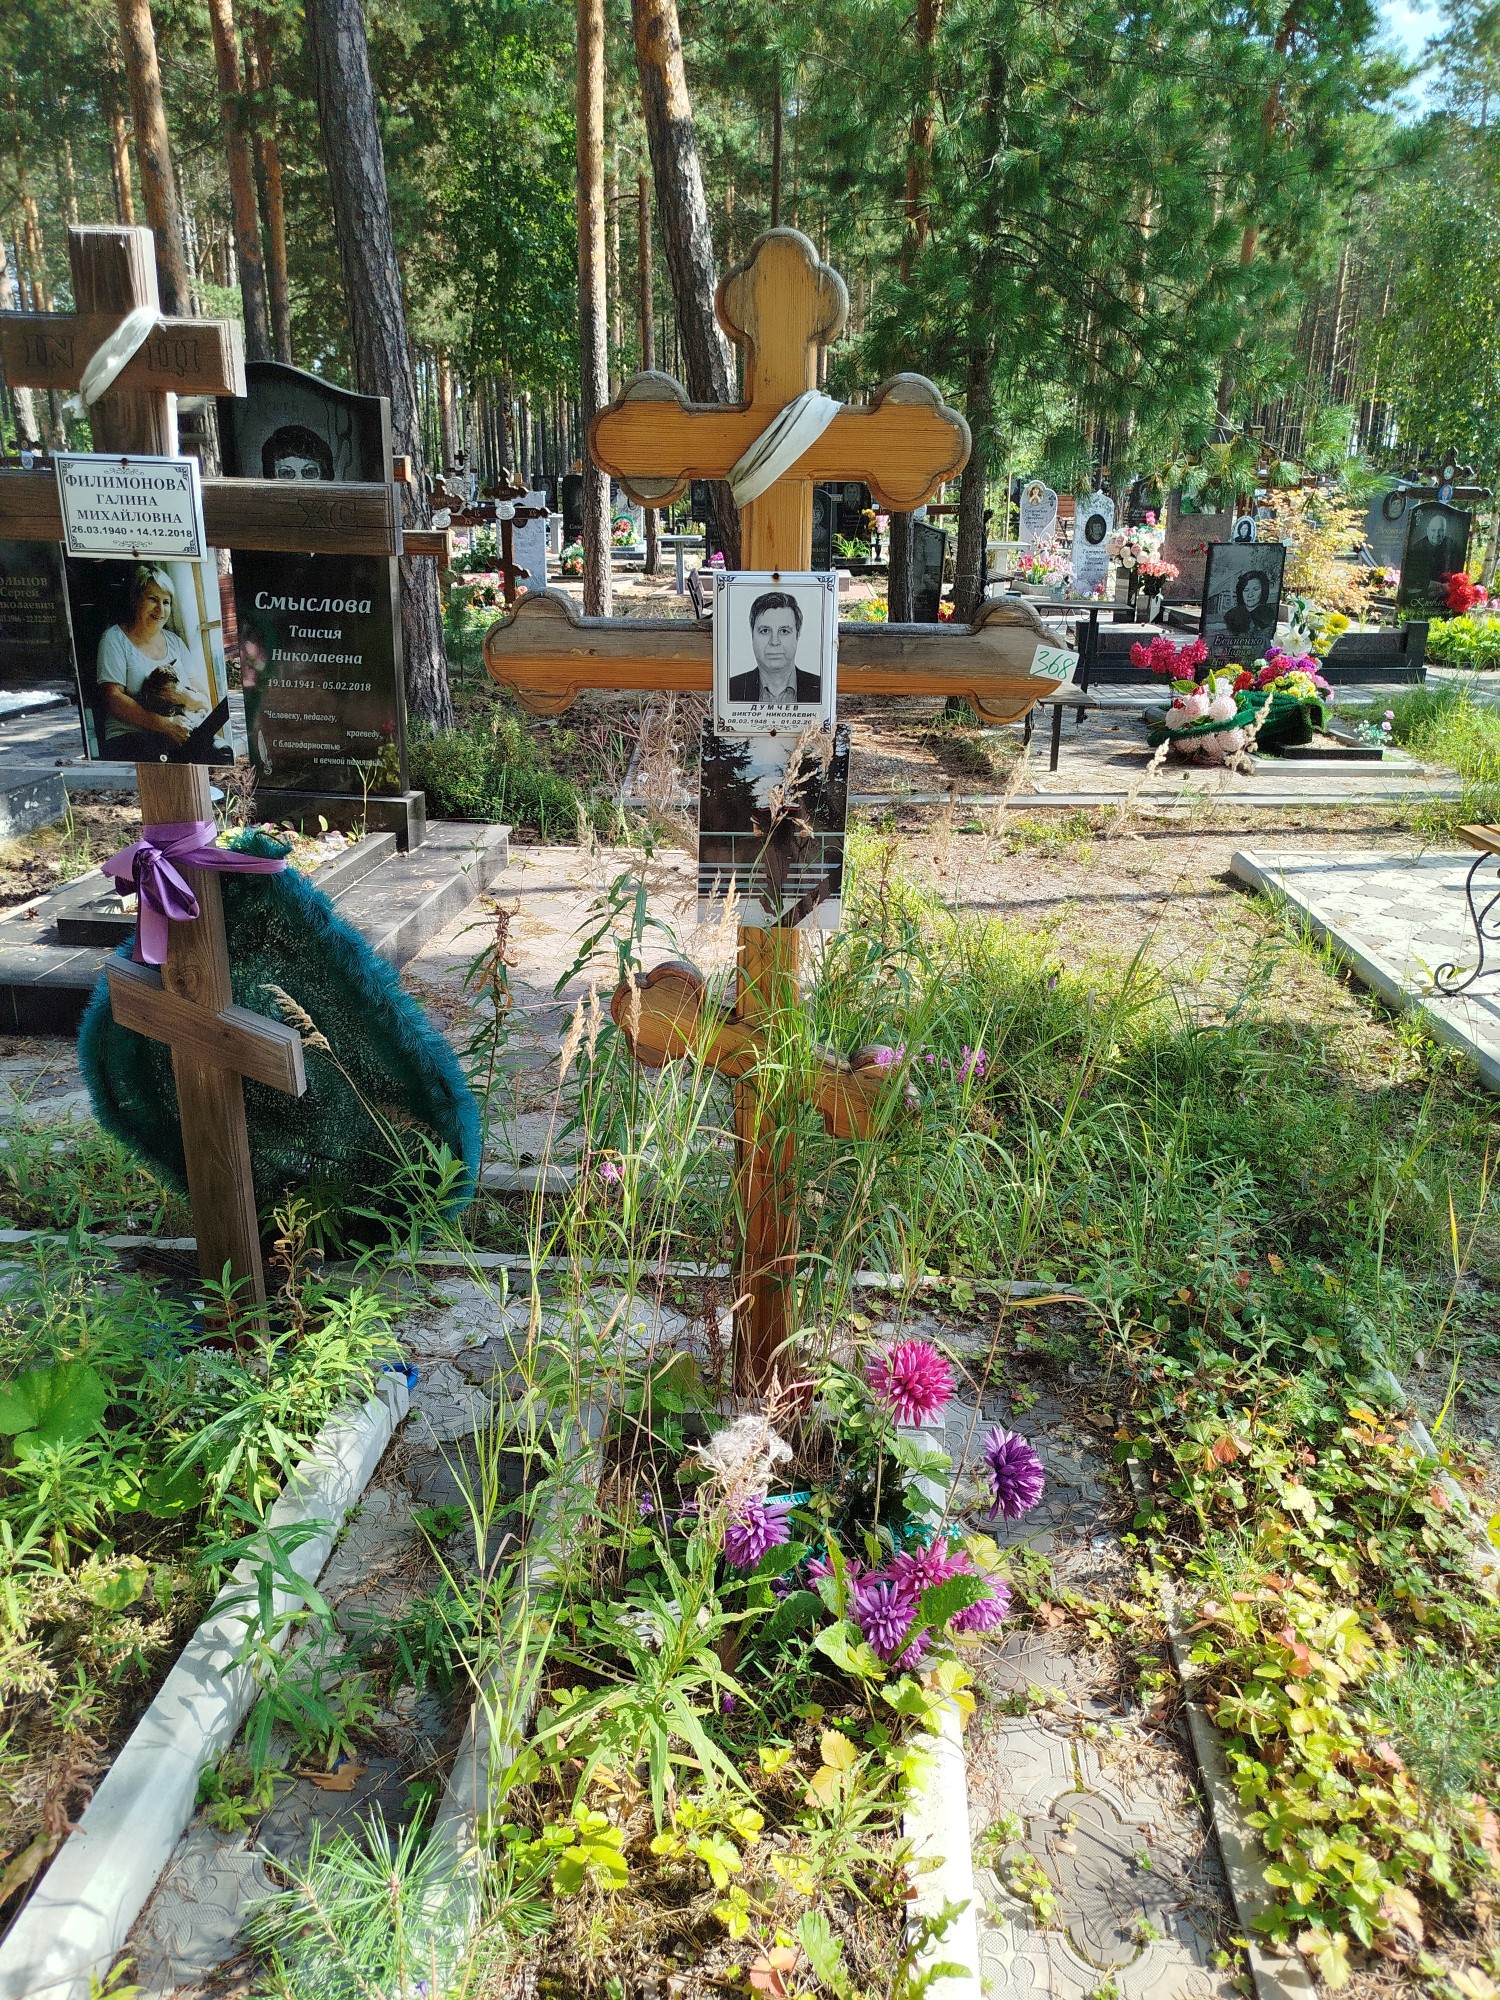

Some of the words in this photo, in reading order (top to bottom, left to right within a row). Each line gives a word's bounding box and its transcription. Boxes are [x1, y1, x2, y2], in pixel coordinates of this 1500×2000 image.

[65, 474, 188, 492] ФИЛИМОНОВА
[96, 493, 159, 507] ГАЛИНА
[77, 509, 183, 524] МИХАЙЛОВНА
[71, 525, 127, 535] 26.03.1940
[136, 528, 193, 538] 14.12.2018
[254, 591, 372, 614] Смыслова
[289, 624, 342, 640] Таисия
[271, 648, 363, 665] Николаевна
[1032, 650, 1076, 680] 368
[267, 678, 315, 689] 19.10.1941
[322, 681, 371, 692] 05.02.2018
[750, 704, 800, 712] ДУМЧЕВ
[765, 711, 818, 719] НИКОЛАЕВИЧ
[727, 718, 768, 726] 08.02.1948
[272, 739, 278, 748] С
[279, 739, 341, 751] благодарностью
[319, 757, 345, 765] вечной
